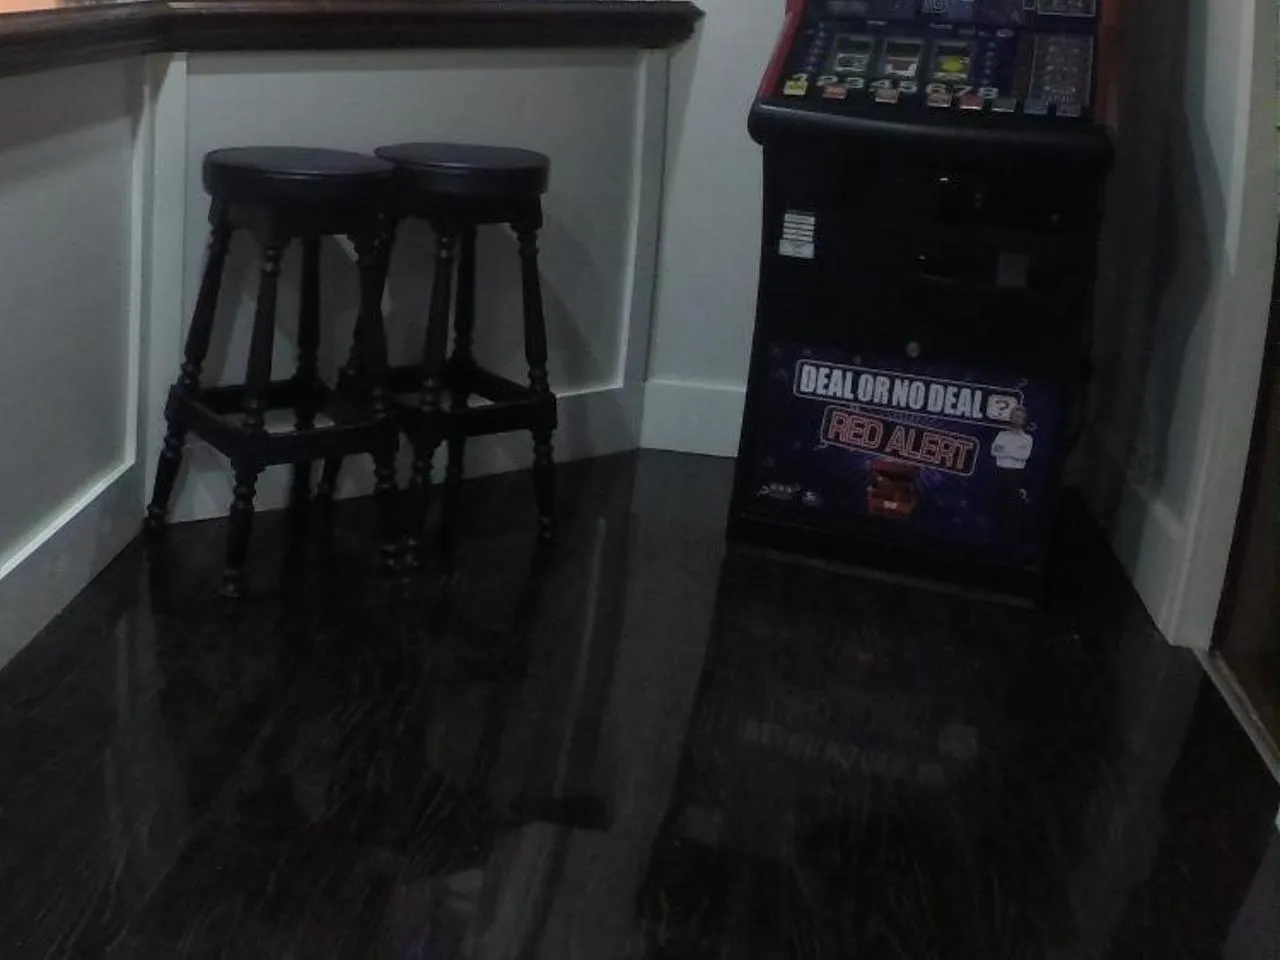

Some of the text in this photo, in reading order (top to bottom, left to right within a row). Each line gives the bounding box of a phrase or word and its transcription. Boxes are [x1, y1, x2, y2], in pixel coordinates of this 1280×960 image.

[799, 364, 984, 418] DEAL OR NO DEAL
[828, 411, 974, 470] RED ALERT
